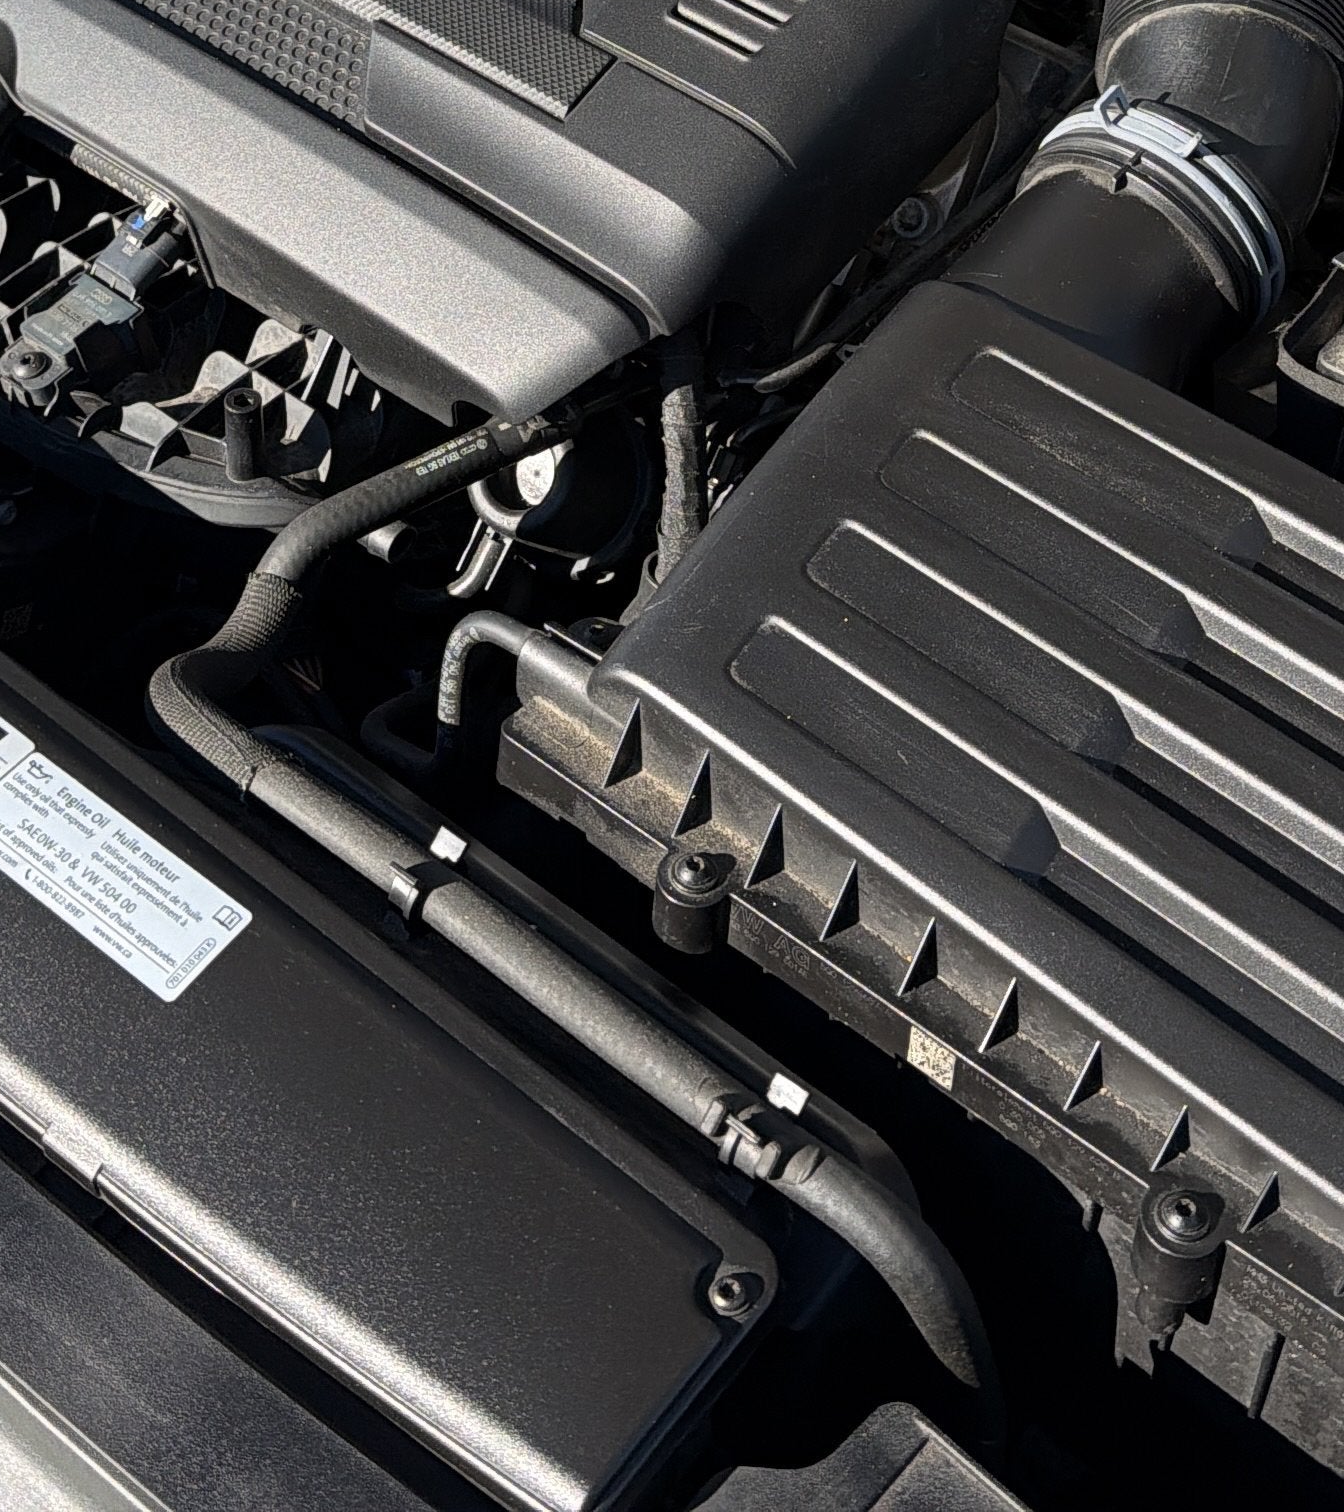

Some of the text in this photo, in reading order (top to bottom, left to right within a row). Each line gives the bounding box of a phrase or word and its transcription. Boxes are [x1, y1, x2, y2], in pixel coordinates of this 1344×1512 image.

[1, 779, 51, 819] complies with
[10, 770, 98, 839] Use only oil that expressly
[52, 784, 111, 829] Engine Oil
[0, 826, 15, 838] of
[8, 832, 46, 863] approved
[39, 857, 60, 875] oils:
[110, 827, 183, 884] Huile moteur
[62, 874, 84, 894] Pour
[78, 887, 98, 904] une
[92, 898, 113, 916] liste
[106, 909, 139, 937] d'huiles
[66, 856, 83, 871] &
[77, 865, 104, 888] VW
[96, 880, 124, 903] 504
[117, 896, 139, 915] 00
[89, 848, 107, 864] qui
[101, 857, 135, 885] satisfait
[129, 879, 184, 923] expressément
[98, 839, 205, 924] Utilisez uniquement de l'huile
[90, 923, 134, 960] www.vw.ca
